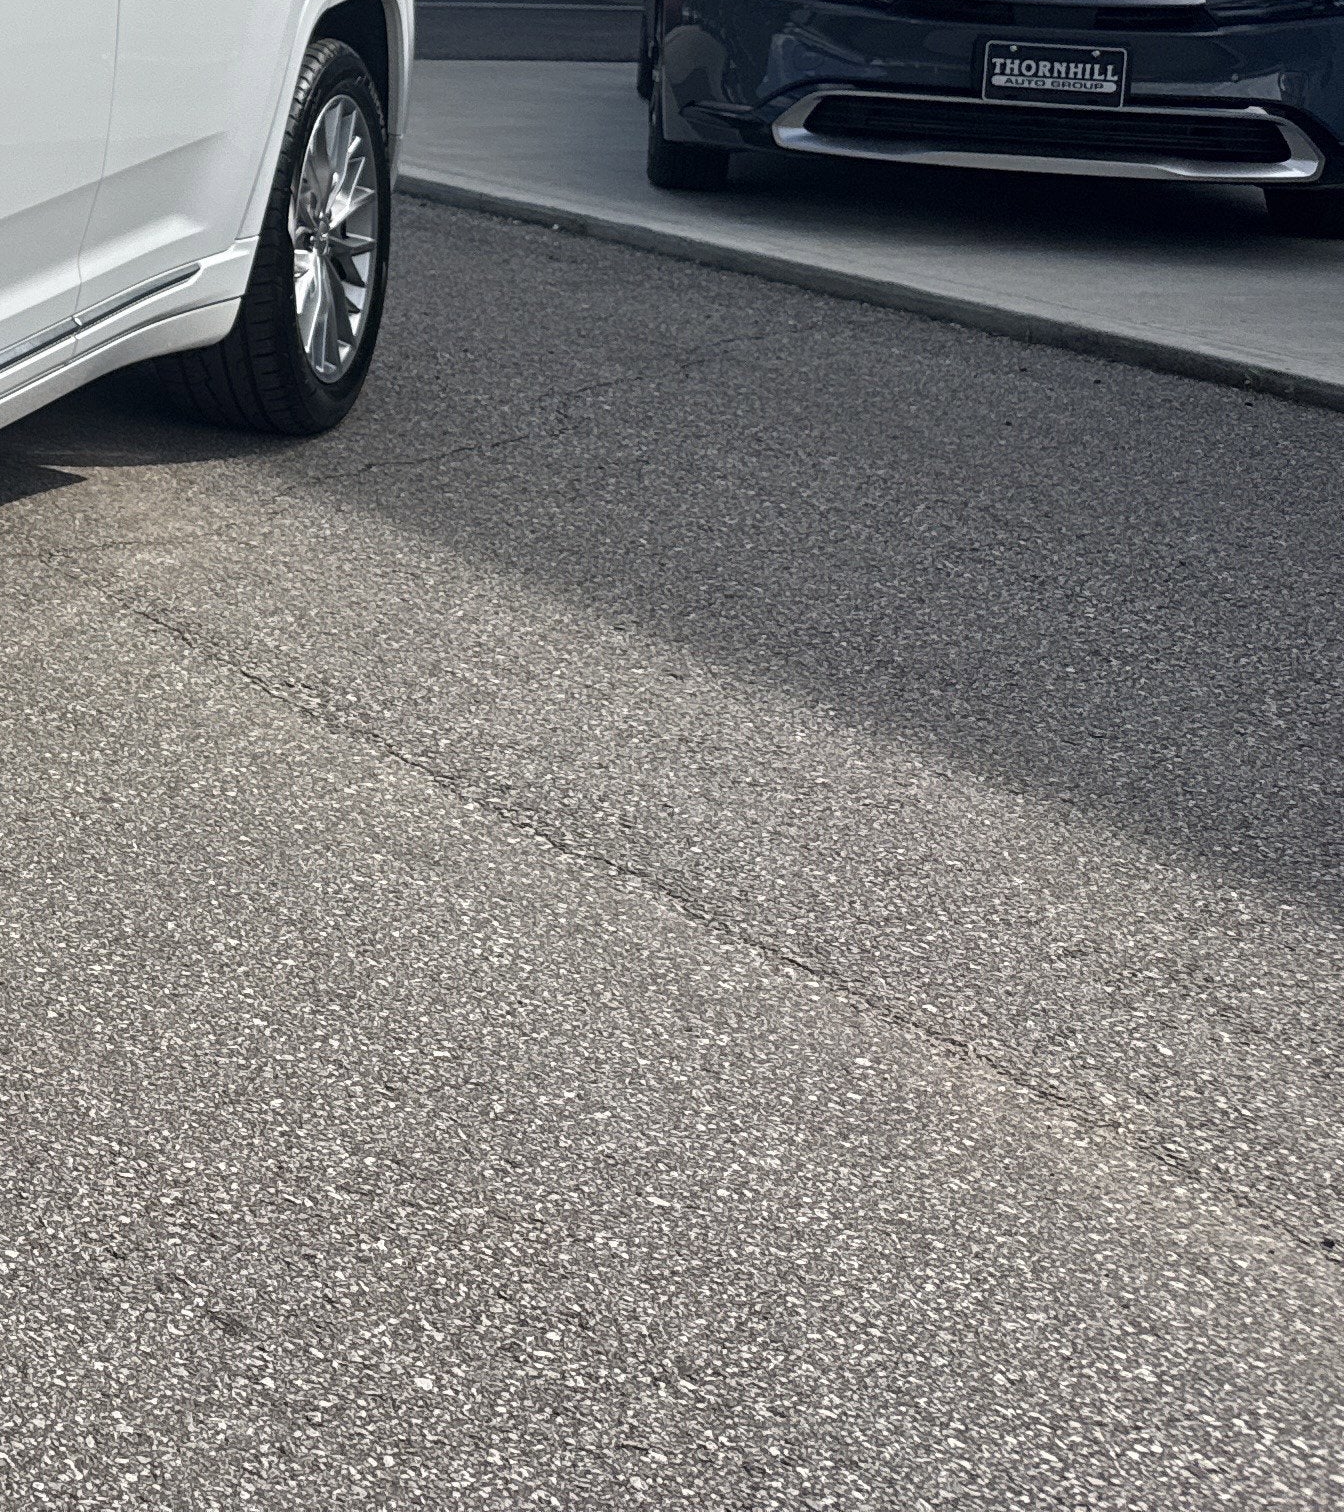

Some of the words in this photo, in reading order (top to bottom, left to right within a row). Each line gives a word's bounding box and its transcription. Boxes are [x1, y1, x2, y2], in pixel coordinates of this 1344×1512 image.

[991, 57, 1119, 81] THORNHILL
[1004, 77, 1046, 88] AUTO
[1050, 79, 1105, 90] GROUP
